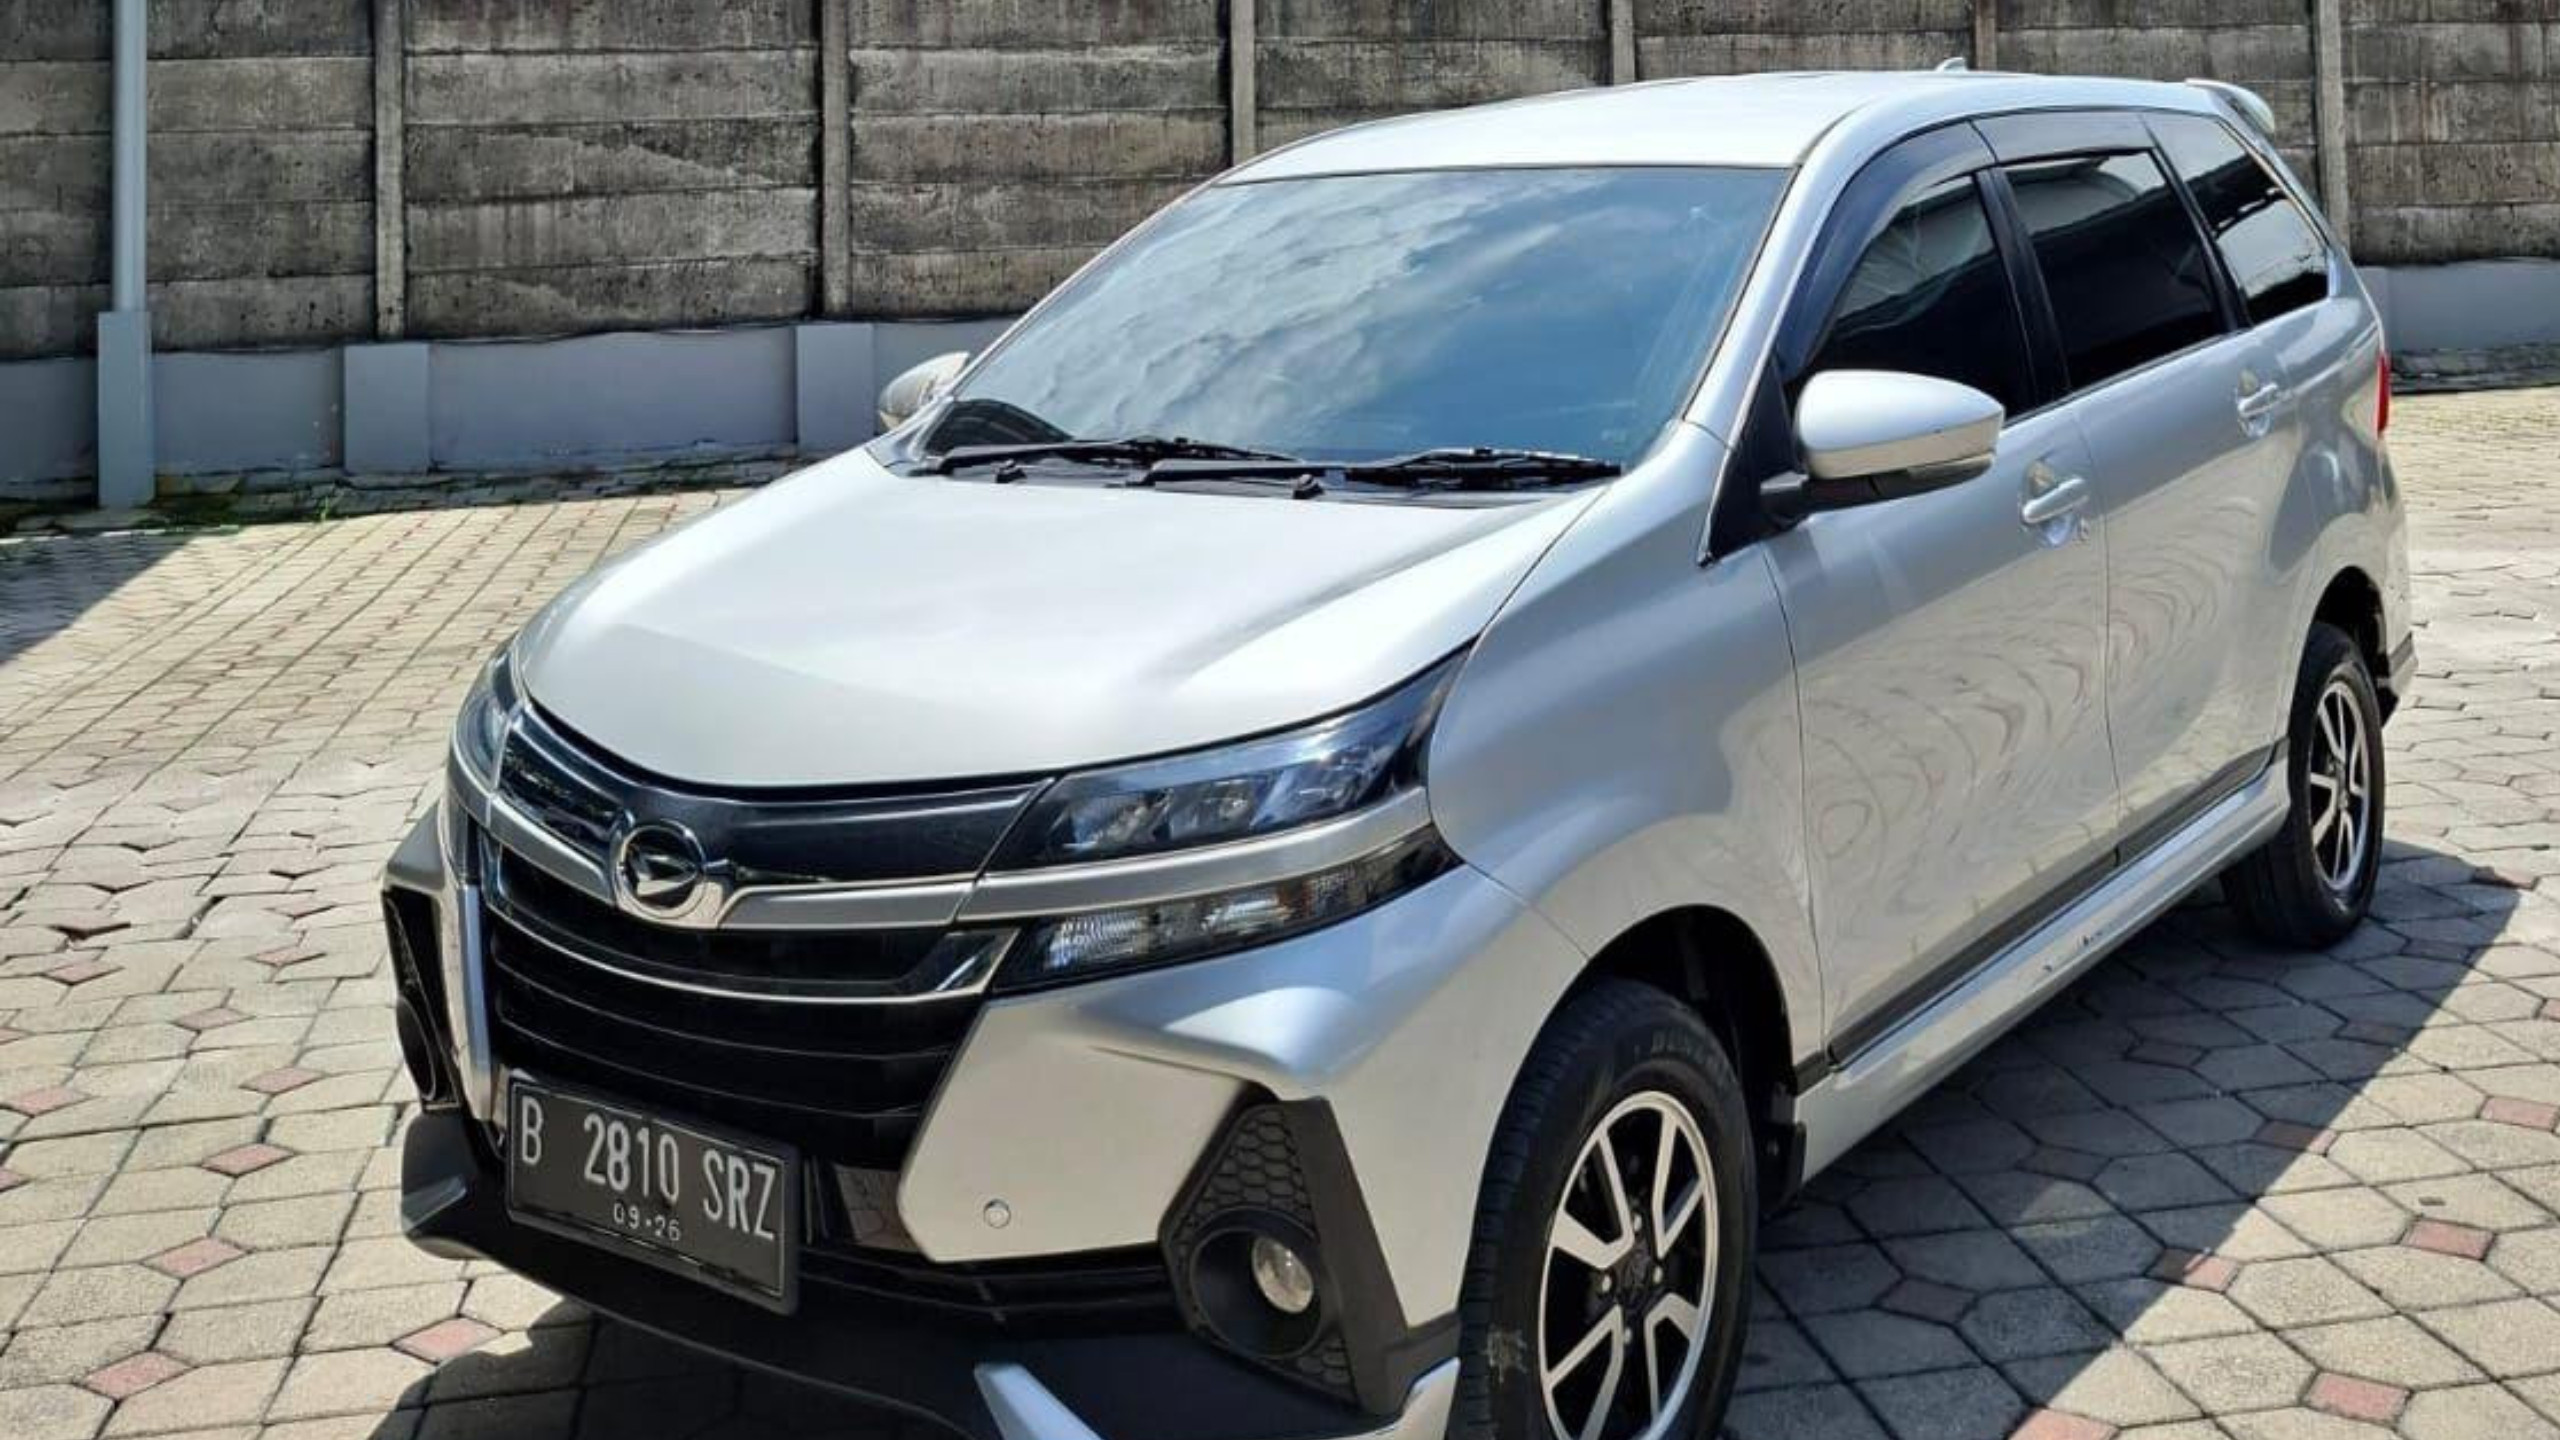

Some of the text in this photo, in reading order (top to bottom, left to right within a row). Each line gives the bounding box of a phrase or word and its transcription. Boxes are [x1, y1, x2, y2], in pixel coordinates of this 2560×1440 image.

[521, 1095, 776, 1240] B 2810 SRZ
